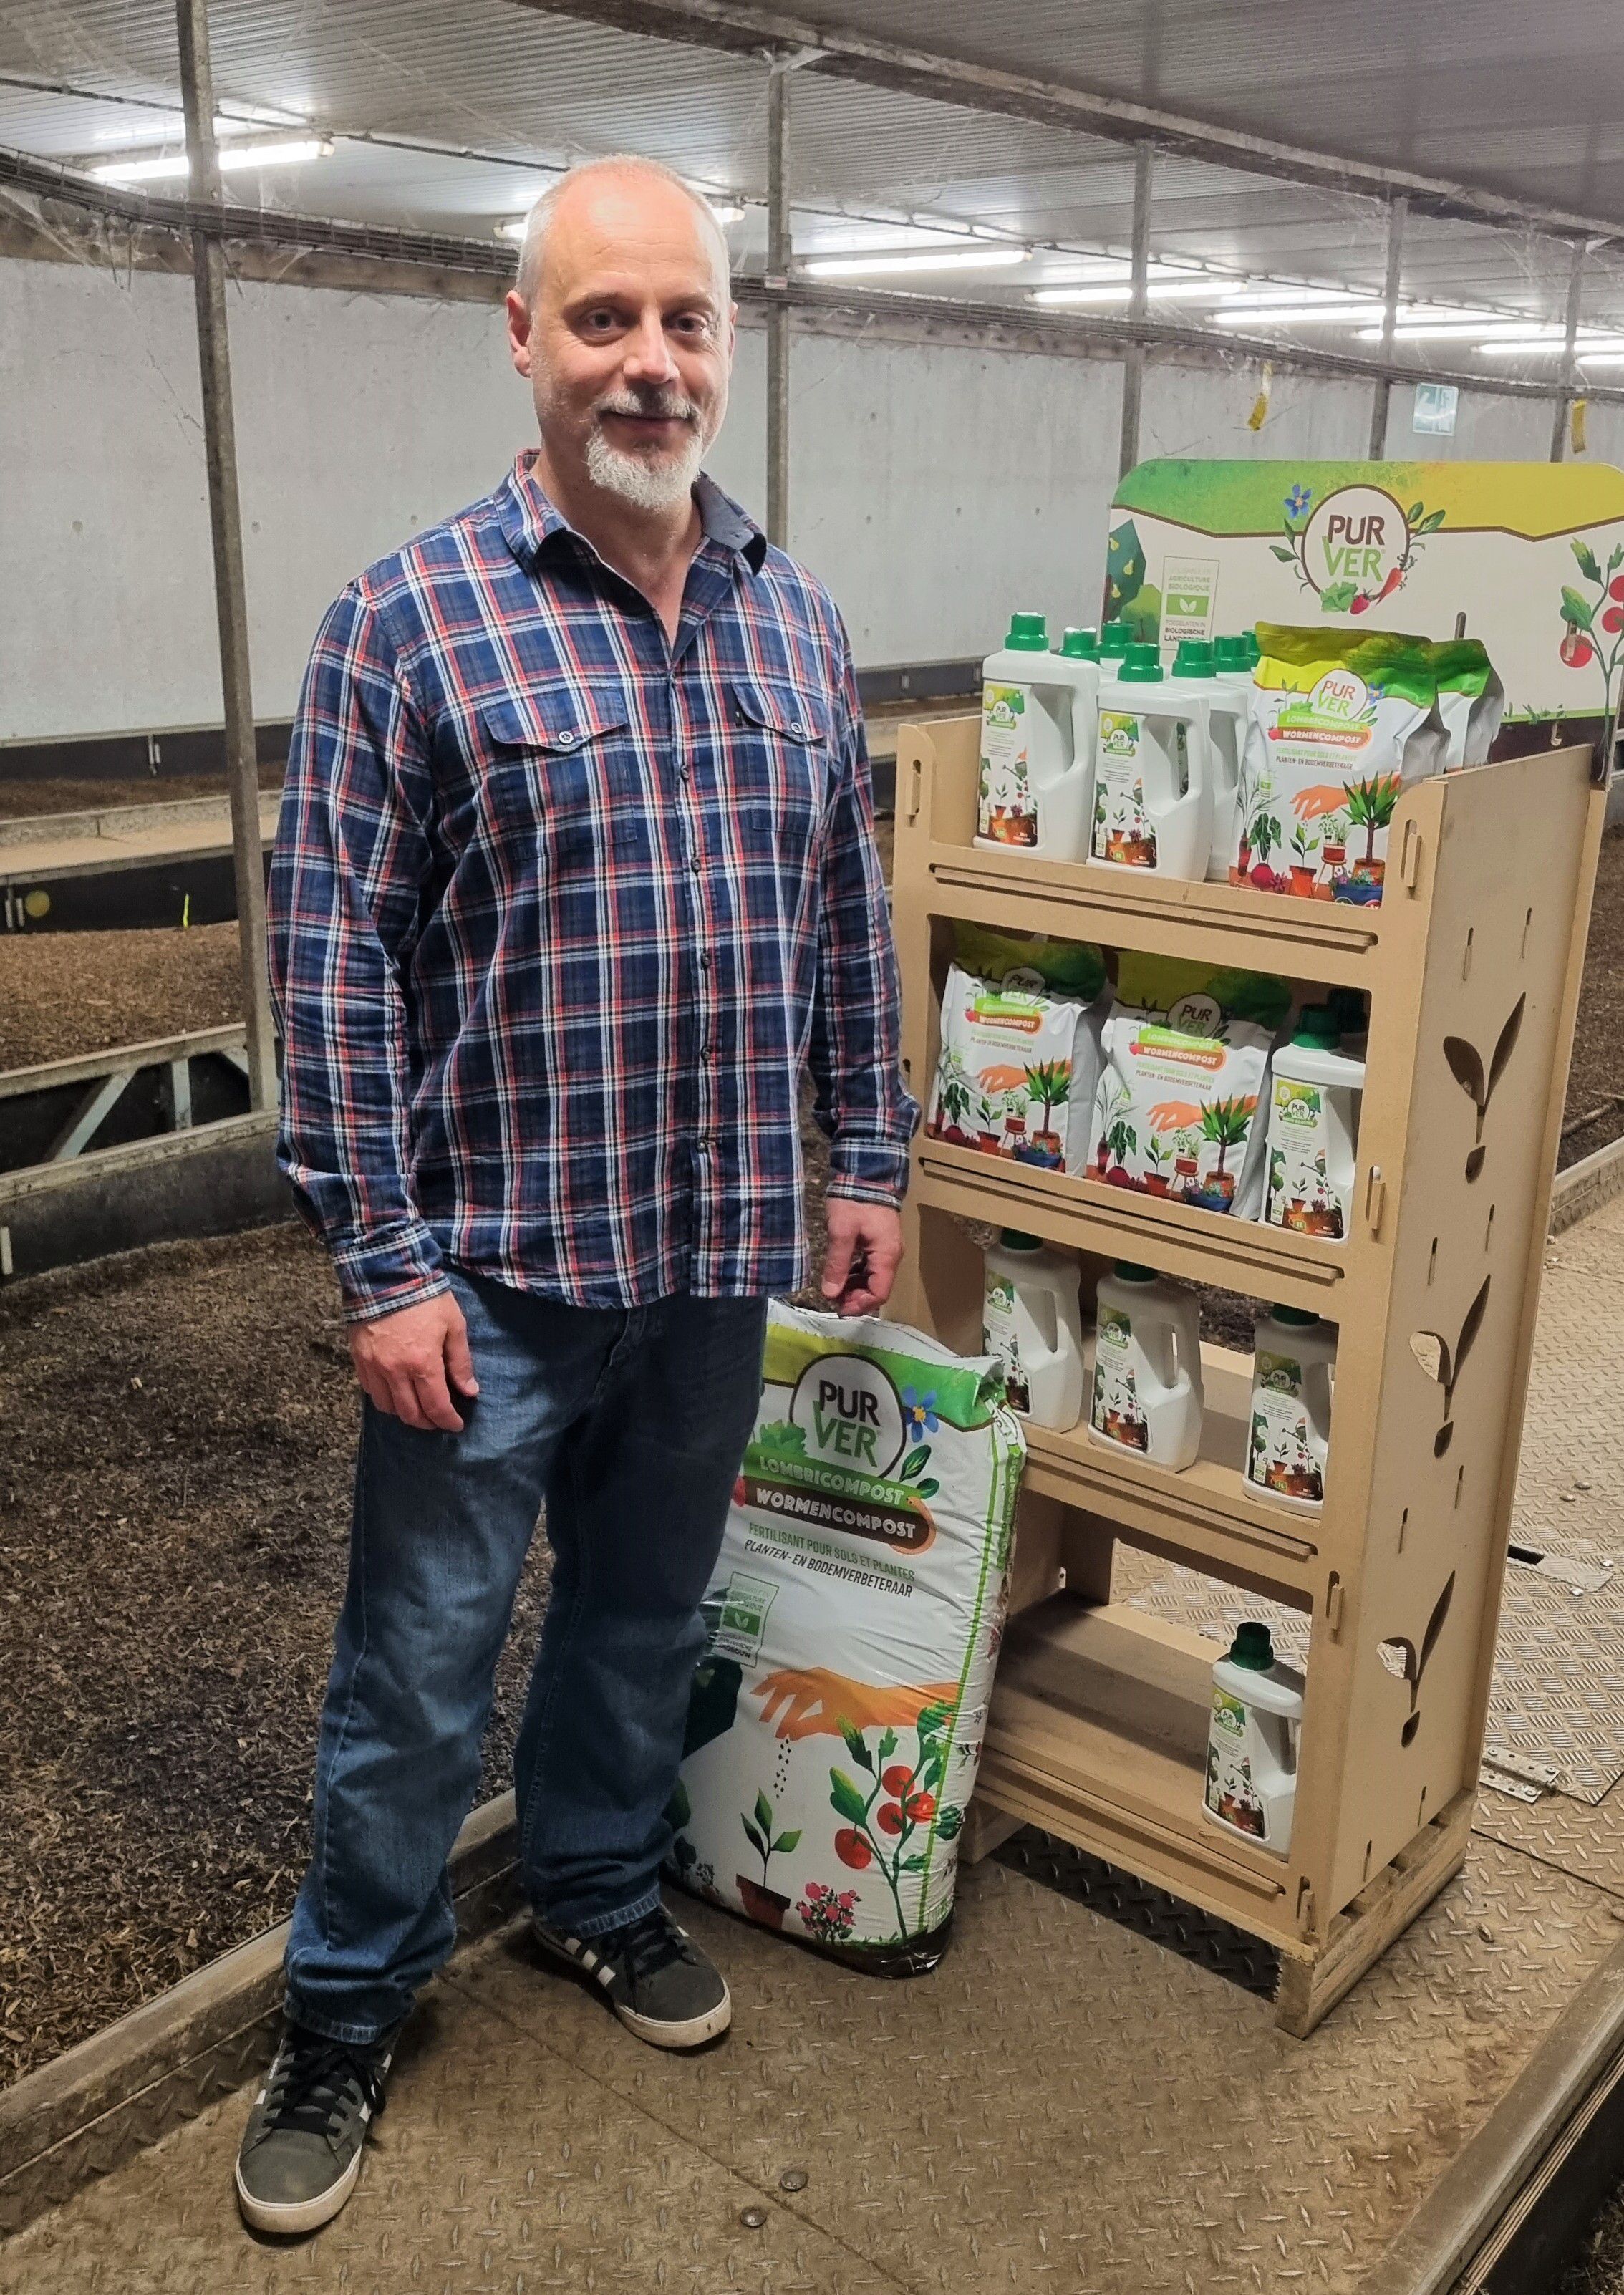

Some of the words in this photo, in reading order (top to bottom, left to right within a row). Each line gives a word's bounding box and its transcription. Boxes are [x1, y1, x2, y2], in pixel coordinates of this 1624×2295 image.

[1328, 514, 1385, 546] PUR
[1322, 536, 1383, 582] VER
[1318, 690, 1350, 717] VER
[1323, 680, 1355, 700] PUR
[1282, 730, 1361, 744] WORMENCOMPOST
[1182, 1004, 1212, 1022] PUR
[1143, 1046, 1218, 1066] WORMENCOMPOST
[818, 1379, 881, 1427] PUR
[812, 1400, 878, 1468] VER
[759, 1456, 905, 1505] LOMBRICOMPOST
[756, 1487, 916, 1539] WORMENCOMPOST
[745, 1539, 792, 1561] PLANTEN-
[792, 1554, 807, 1567] EN
[807, 1558, 913, 1598] BODEMVERBETERAAR
[749, 1522, 805, 1548] FERTILISANT
[807, 1540, 832, 1557] POUR
[834, 1547, 859, 1564] SOLS
[860, 1555, 871, 1568] ET
[873, 1559, 915, 1582] PLANTES
